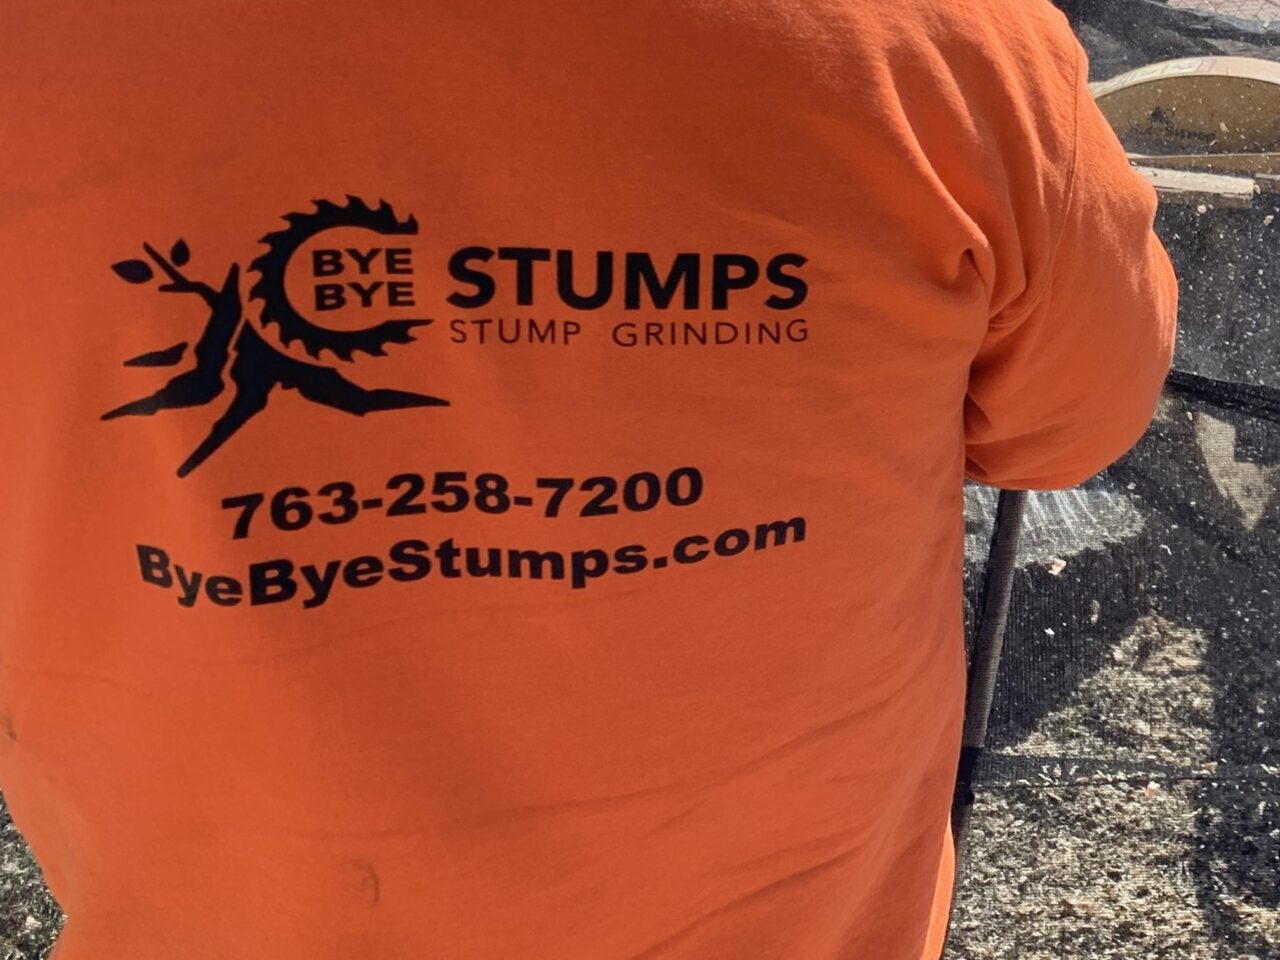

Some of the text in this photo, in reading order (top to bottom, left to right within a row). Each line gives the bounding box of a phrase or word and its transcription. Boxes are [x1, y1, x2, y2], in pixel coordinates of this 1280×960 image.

[311, 247, 414, 278] BYE
[446, 245, 810, 311] STUMPS
[313, 281, 417, 312] BYE
[449, 318, 810, 348] STUMP GRINDING
[221, 466, 705, 541] 763-258-7200
[135, 516, 808, 608] ByeByeStumps.com
